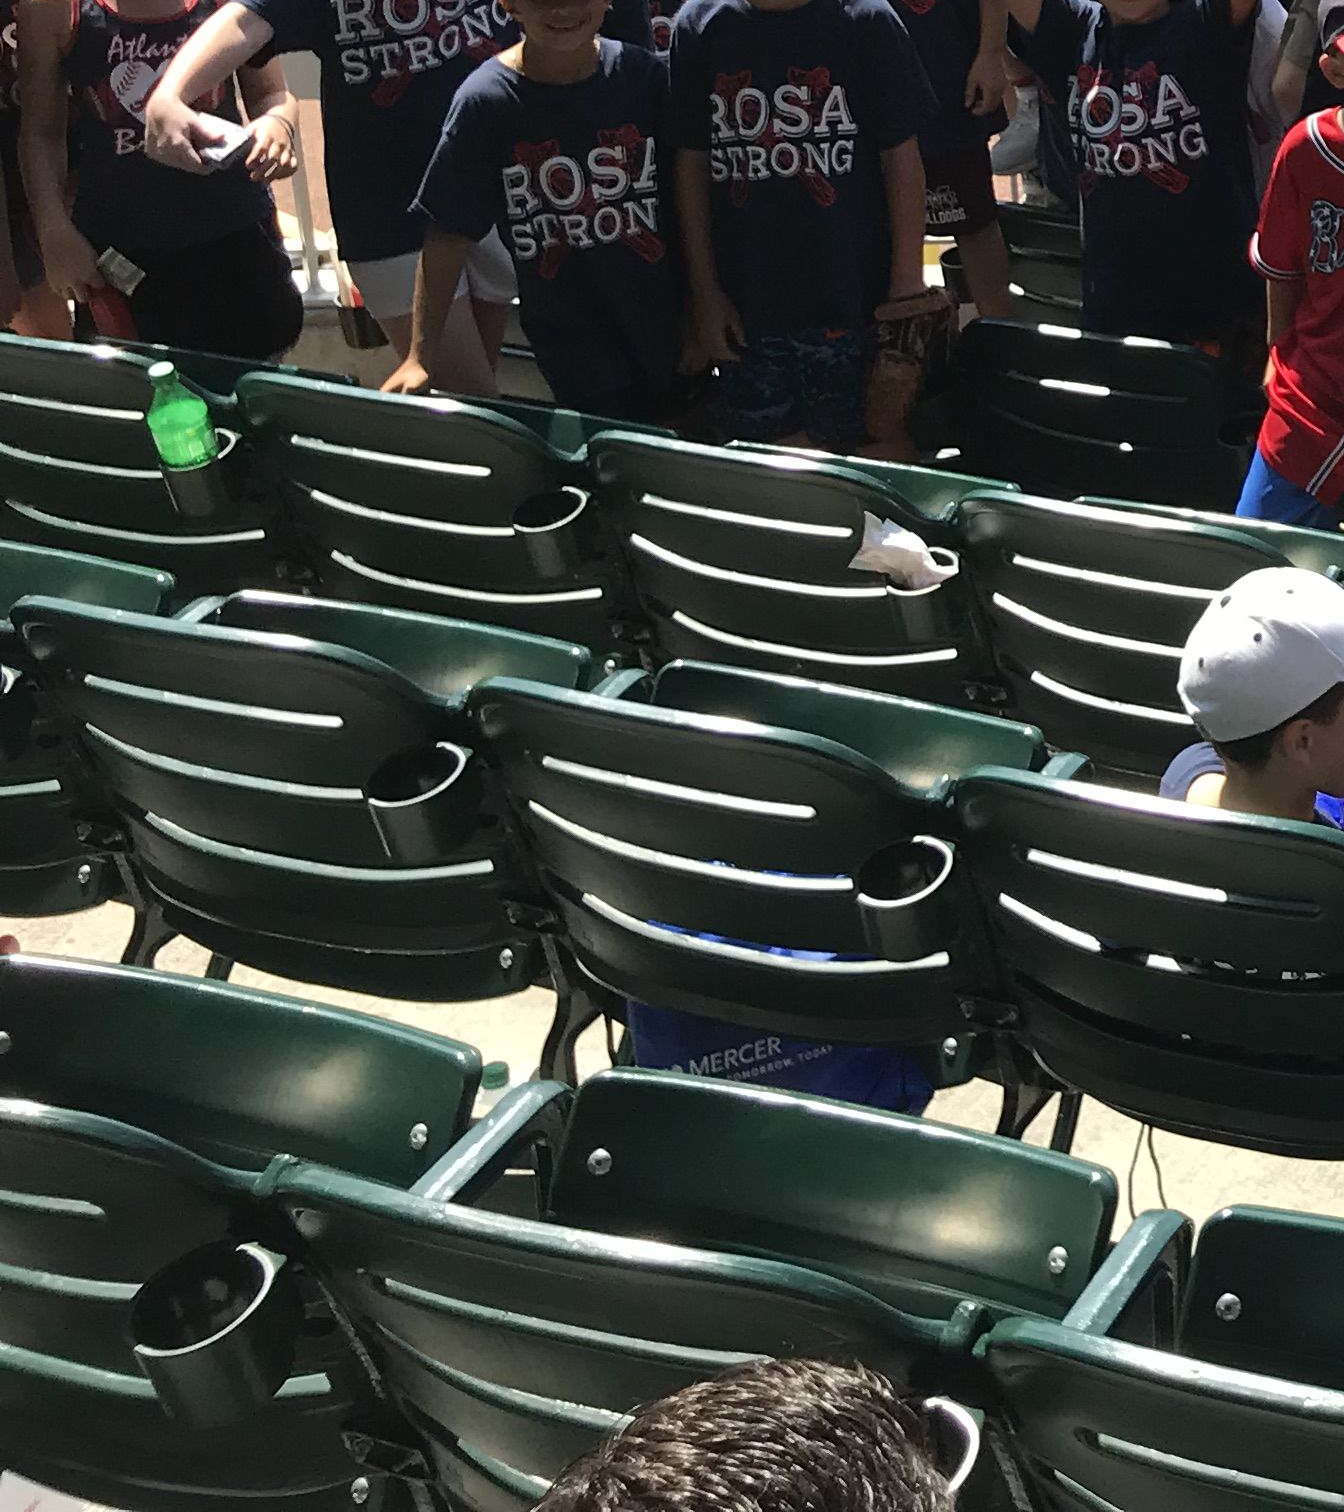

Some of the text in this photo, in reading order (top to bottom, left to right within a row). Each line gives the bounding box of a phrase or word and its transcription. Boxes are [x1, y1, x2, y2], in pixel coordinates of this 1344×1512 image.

[711, 84, 859, 144] ROSA
[710, 139, 856, 183] STRONG
[512, 196, 659, 262] STRON
[689, 1035, 783, 1077] MERCER
